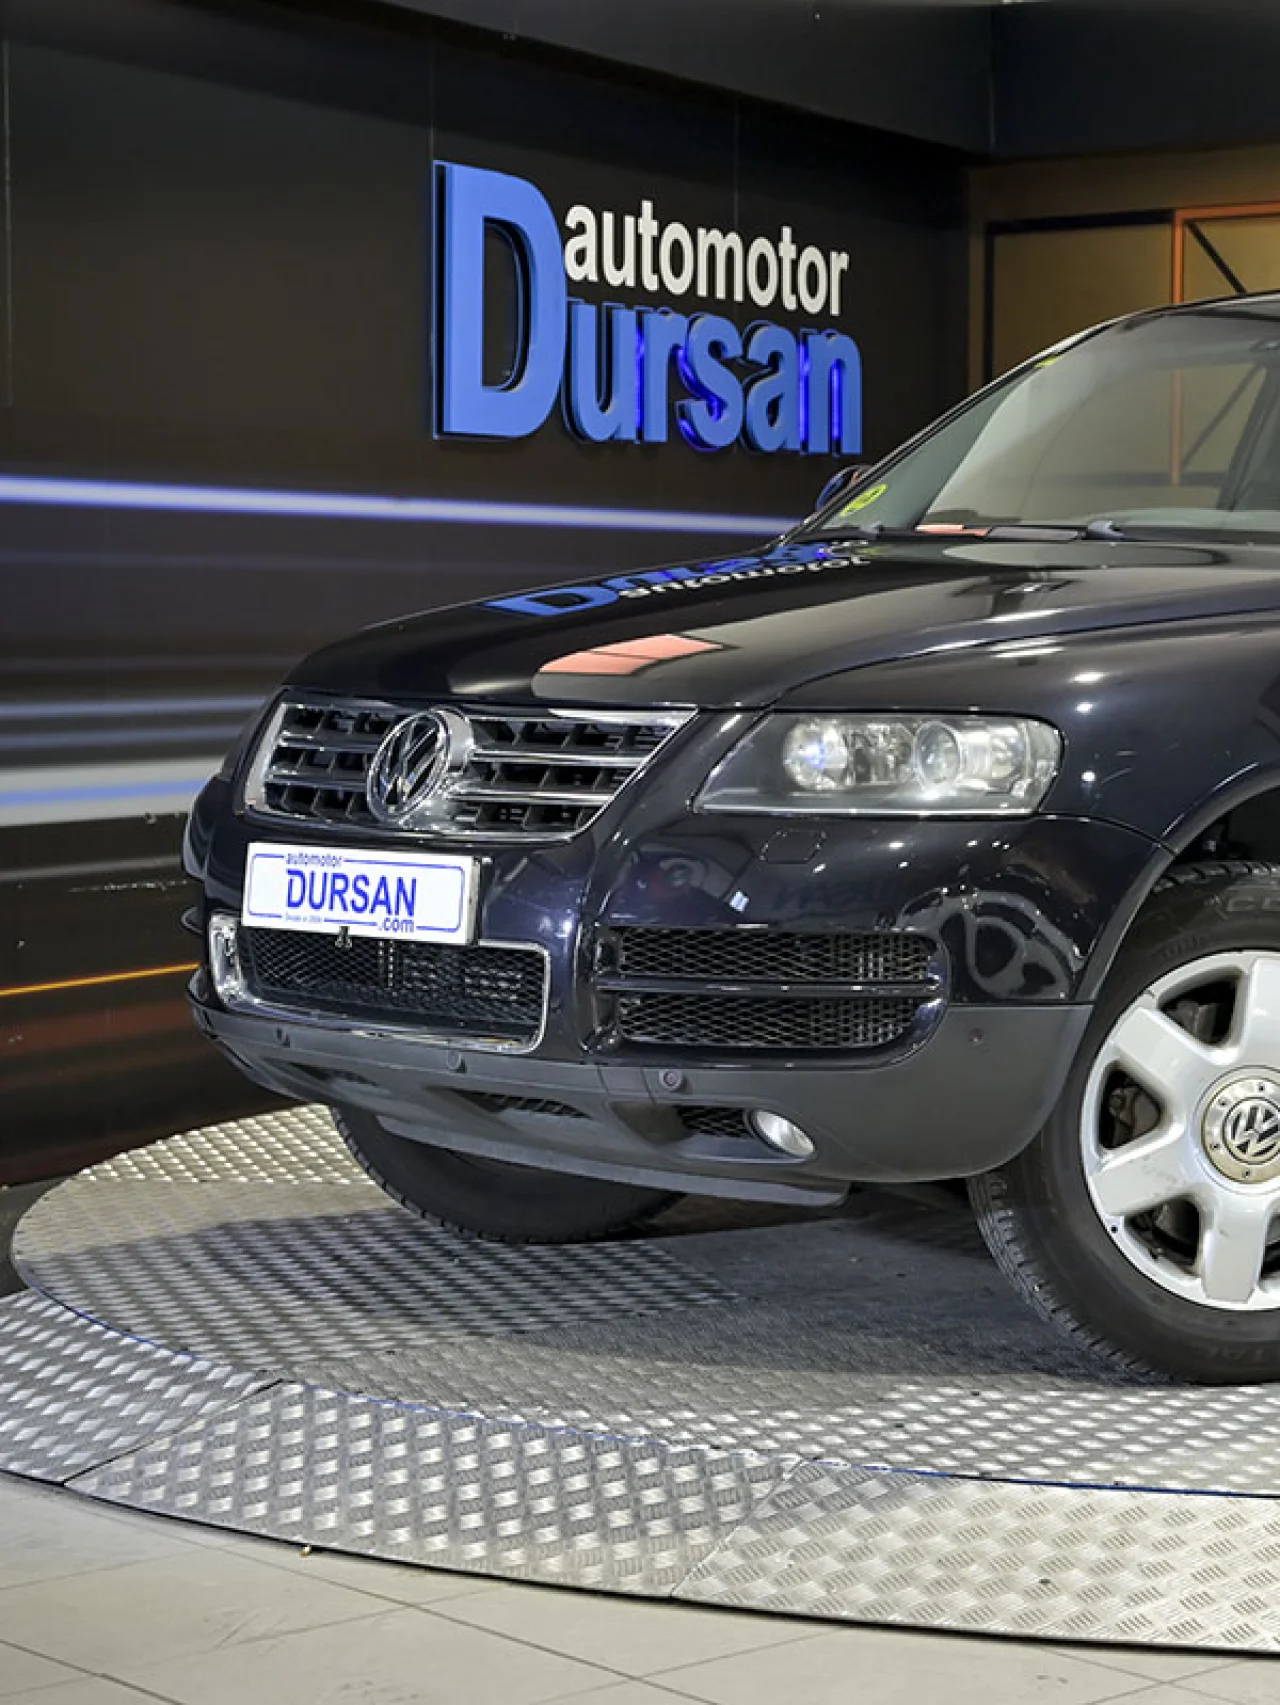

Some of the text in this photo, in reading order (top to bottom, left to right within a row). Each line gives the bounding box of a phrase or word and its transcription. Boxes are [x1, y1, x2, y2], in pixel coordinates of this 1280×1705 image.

[564, 200, 850, 316] automotor
[433, 160, 863, 457] Dursan
[286, 868, 417, 917] DURSAN
[377, 916, 415, 932] .com
